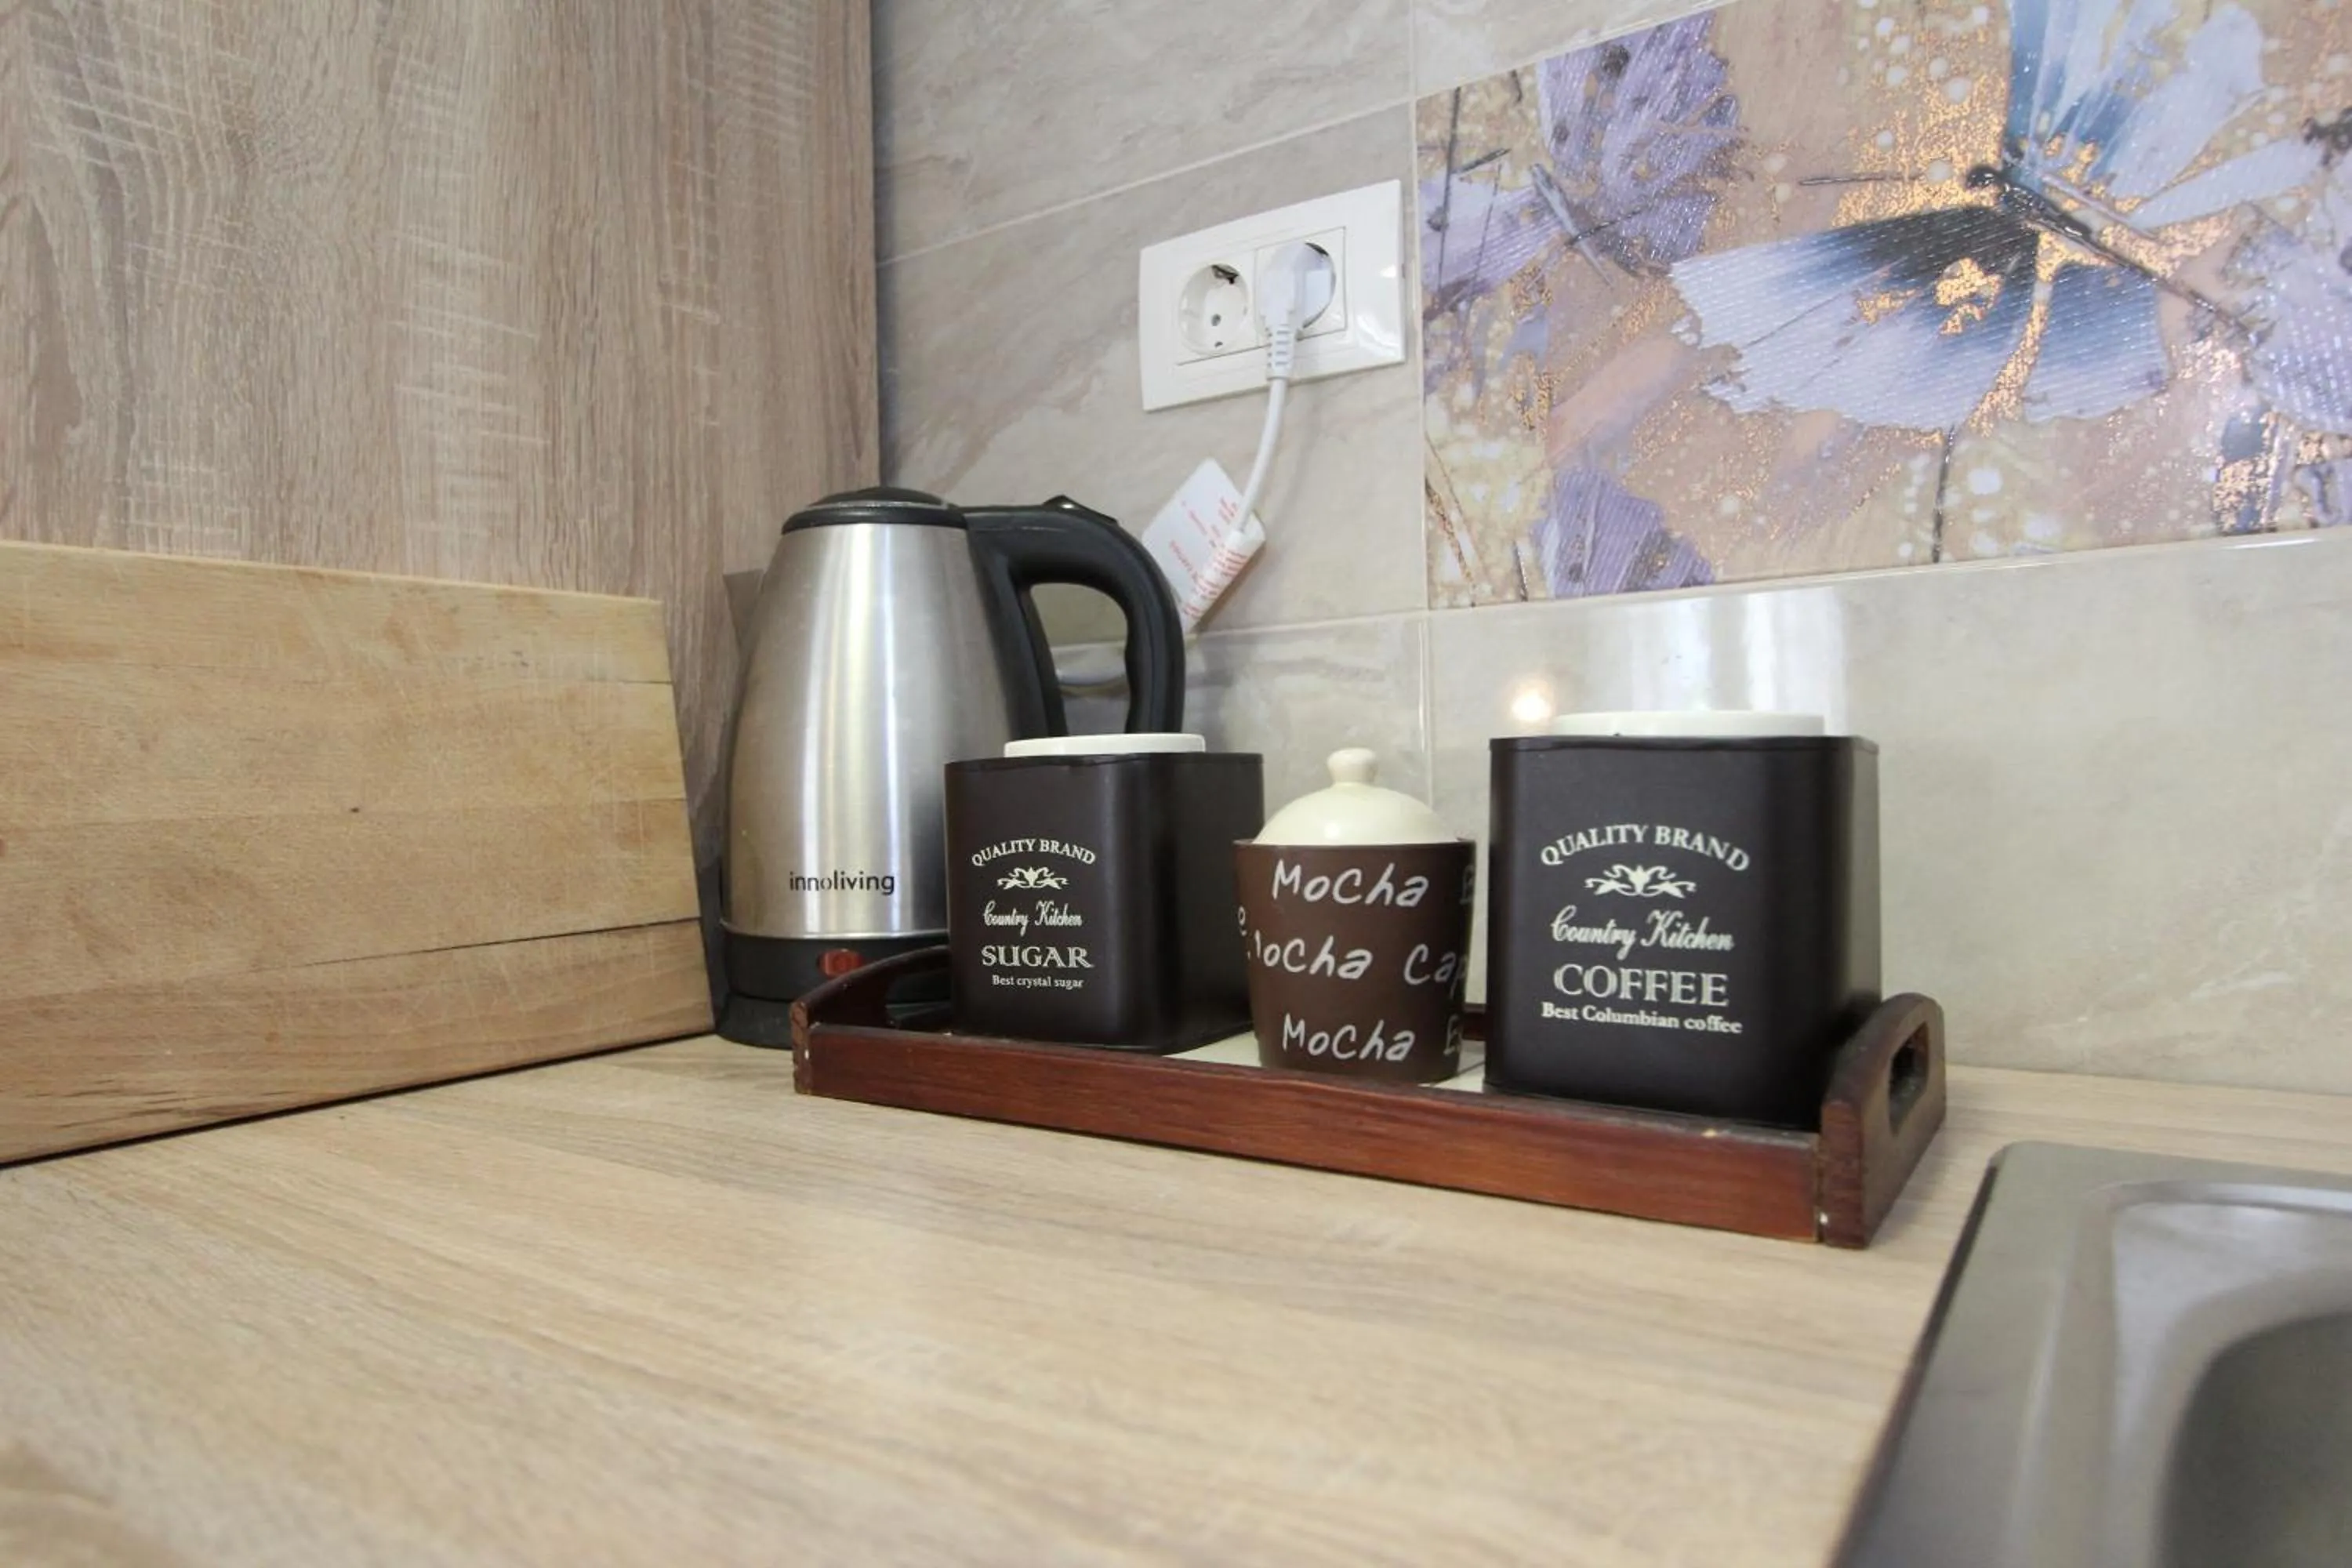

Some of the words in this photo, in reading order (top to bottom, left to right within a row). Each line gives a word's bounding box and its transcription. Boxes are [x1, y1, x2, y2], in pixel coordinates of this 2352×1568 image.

[971, 839, 1036, 866] QUALITY
[1039, 838, 1097, 866] BRAND
[1541, 823, 1648, 866] QUALITY
[1654, 825, 1750, 872] BRAND
[789, 870, 895, 895] innoliving
[982, 900, 1029, 937] Country
[1033, 900, 1083, 927] Kitchen
[1550, 905, 1637, 960] Country
[1639, 909, 1734, 951] Kitchen
[981, 945, 1094, 969] SUGAR
[992, 975, 1014, 985] Best
[1016, 975, 1051, 989] crystal
[1054, 978, 1085, 990] sugar
[1553, 963, 1730, 1007] COFFEE
[1541, 1001, 1579, 1021] Best
[1581, 1004, 1679, 1029] Columbian
[1682, 1014, 1743, 1034] coffee
